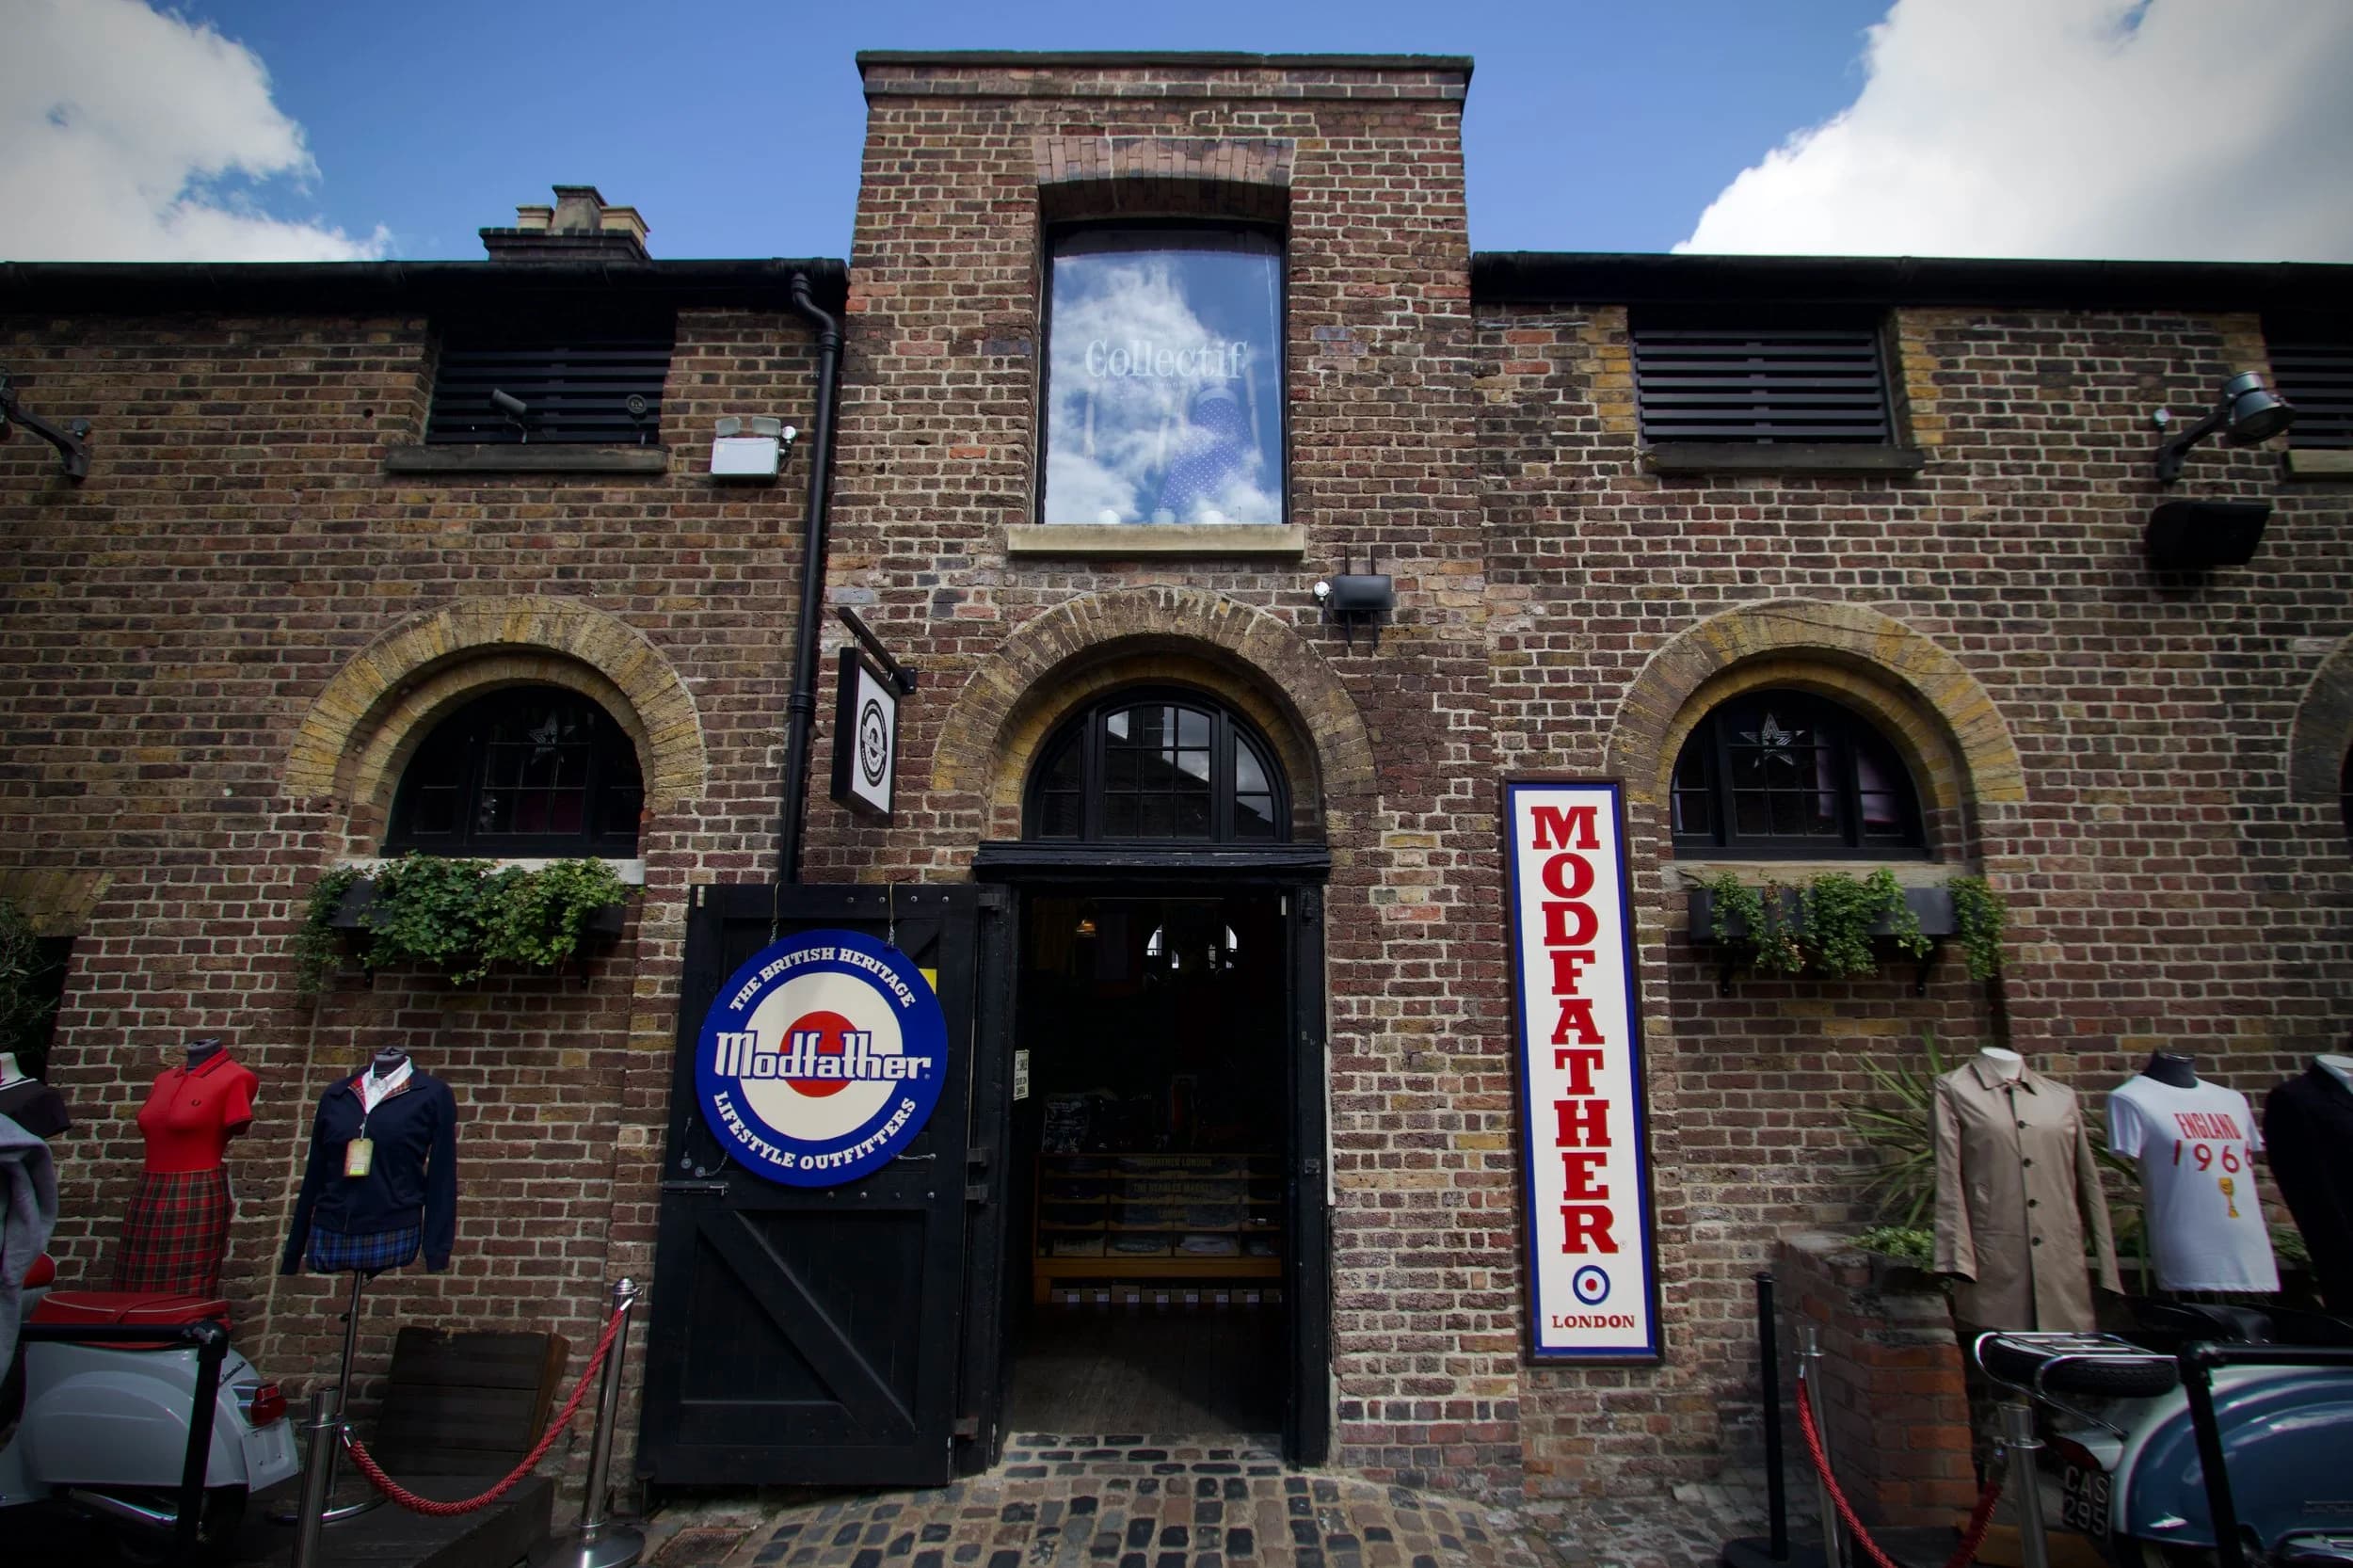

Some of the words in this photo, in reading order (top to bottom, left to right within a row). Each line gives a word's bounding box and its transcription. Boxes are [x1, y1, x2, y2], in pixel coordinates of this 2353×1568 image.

[1085, 339, 1249, 378] Collectif
[729, 976, 762, 1011] THE
[759, 947, 836, 983] BRITISH
[838, 948, 917, 1008] HERITAGE
[1529, 806, 1619, 1254] MODFATHER
[714, 1032, 932, 1080] Modfather
[713, 1090, 796, 1168] LIFESTYLE
[800, 1097, 916, 1170] OUTFITTERS
[2173, 1112, 2242, 1139] ENGLAND
[1551, 1314, 1636, 1329] LONDON
[2065, 1464, 2109, 1504] CAS
[2063, 1495, 2106, 1536] 295
